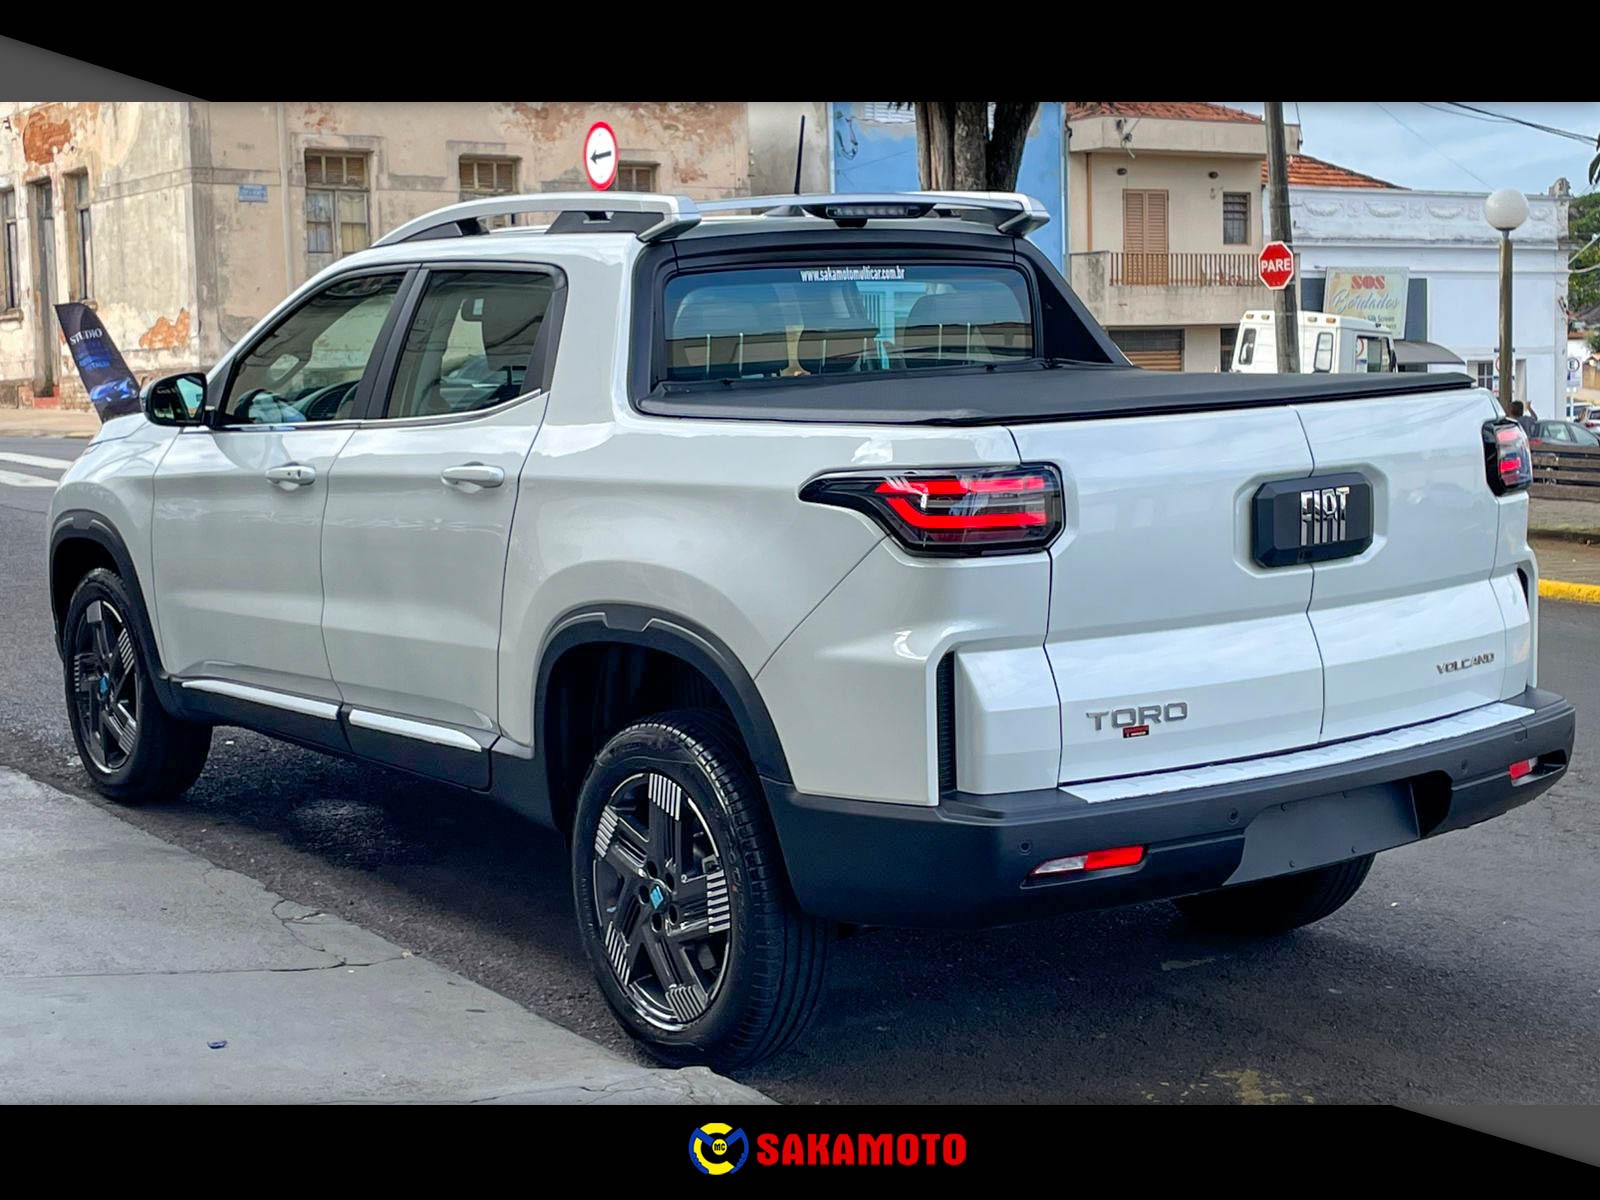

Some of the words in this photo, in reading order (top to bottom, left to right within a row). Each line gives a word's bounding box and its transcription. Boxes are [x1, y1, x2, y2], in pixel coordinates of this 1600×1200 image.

[800, 265, 905, 282] www.sakamotomulticar.com.br
[1261, 258, 1291, 273] PARE
[1351, 275, 1385, 289] SOS
[69, 328, 103, 345] STUDIO
[1300, 486, 1350, 546] FIAT
[1436, 653, 1494, 675] VOLCANO
[1085, 702, 1188, 732] TORO
